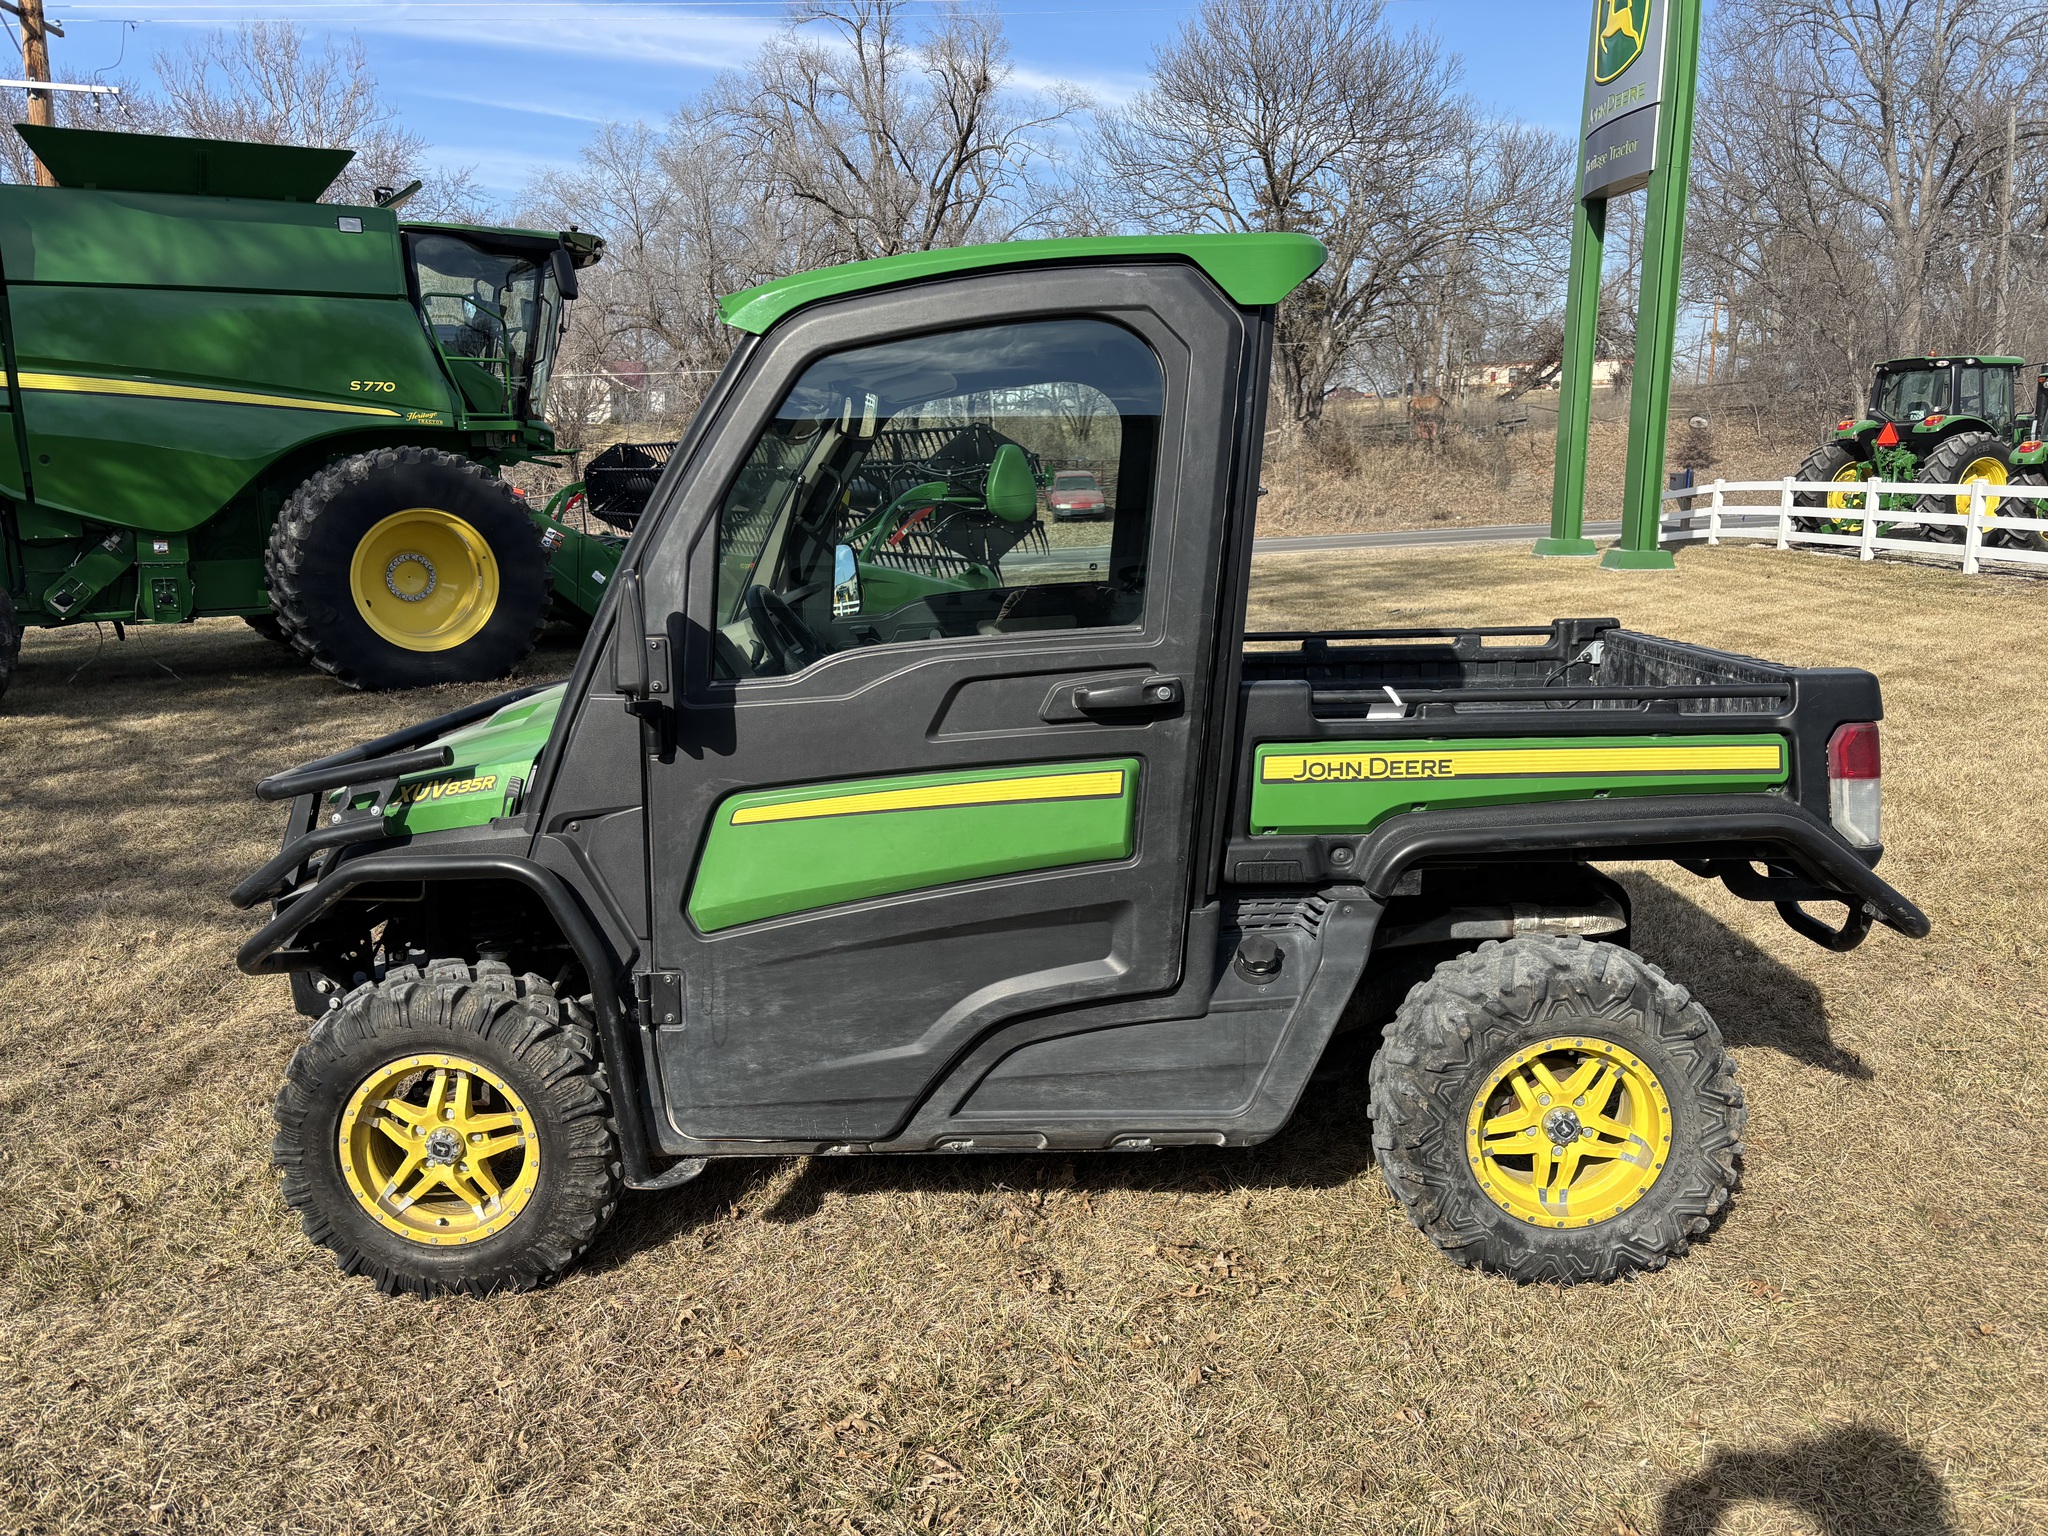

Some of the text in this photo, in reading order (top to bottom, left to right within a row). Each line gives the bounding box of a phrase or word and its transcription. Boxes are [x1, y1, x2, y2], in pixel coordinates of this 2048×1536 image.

[1607, 82, 1646, 114] DEERE
[1609, 139, 1639, 160] Tractor
[406, 411, 438, 421] Heritage
[1293, 757, 1453, 779] JOHN DEERE
[391, 775, 497, 806] XUV835R
